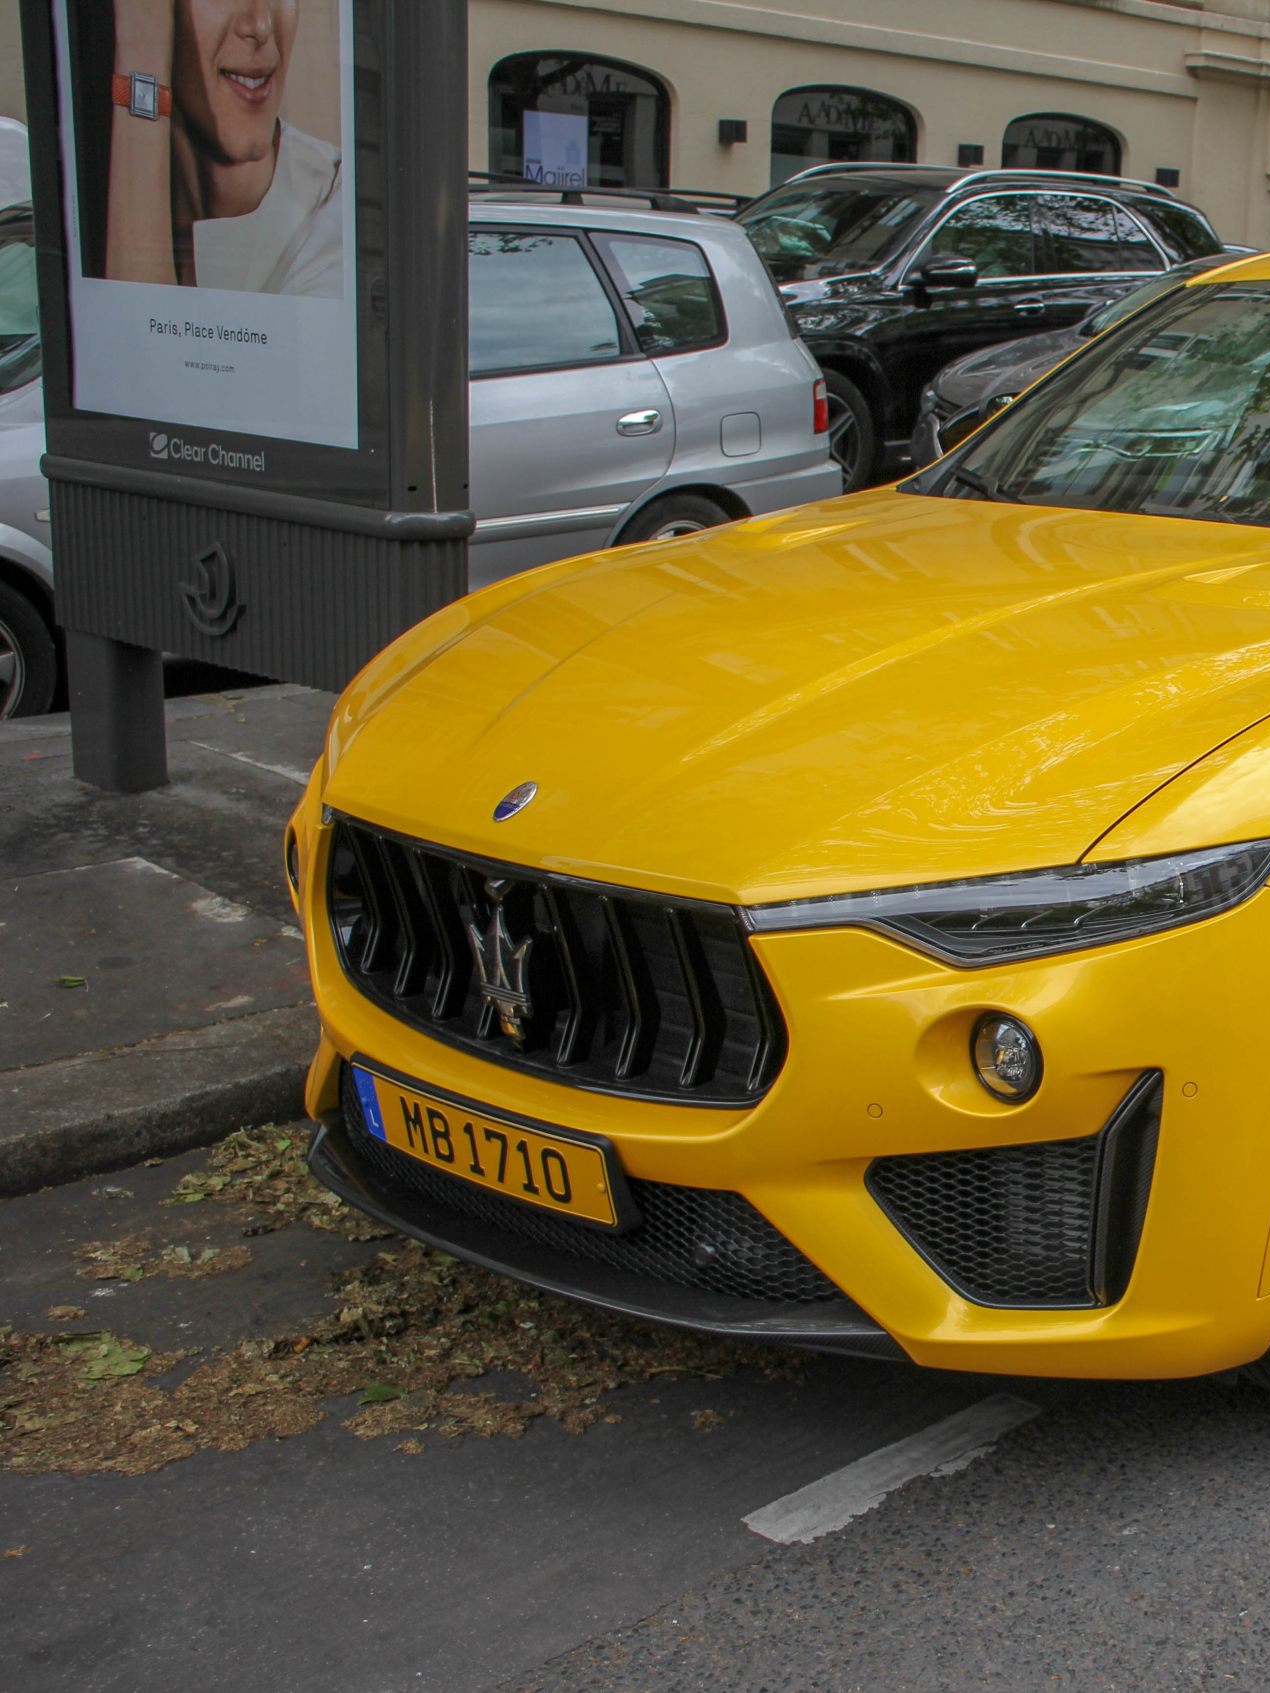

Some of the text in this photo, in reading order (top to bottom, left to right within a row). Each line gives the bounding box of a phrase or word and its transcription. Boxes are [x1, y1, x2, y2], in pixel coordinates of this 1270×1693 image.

[150, 318, 268, 345] Paris, Place Vendôme
[184, 360, 235, 373] www.poiray.com
[170, 438, 265, 472] Clear Channel
[368, 1109, 379, 1128] L
